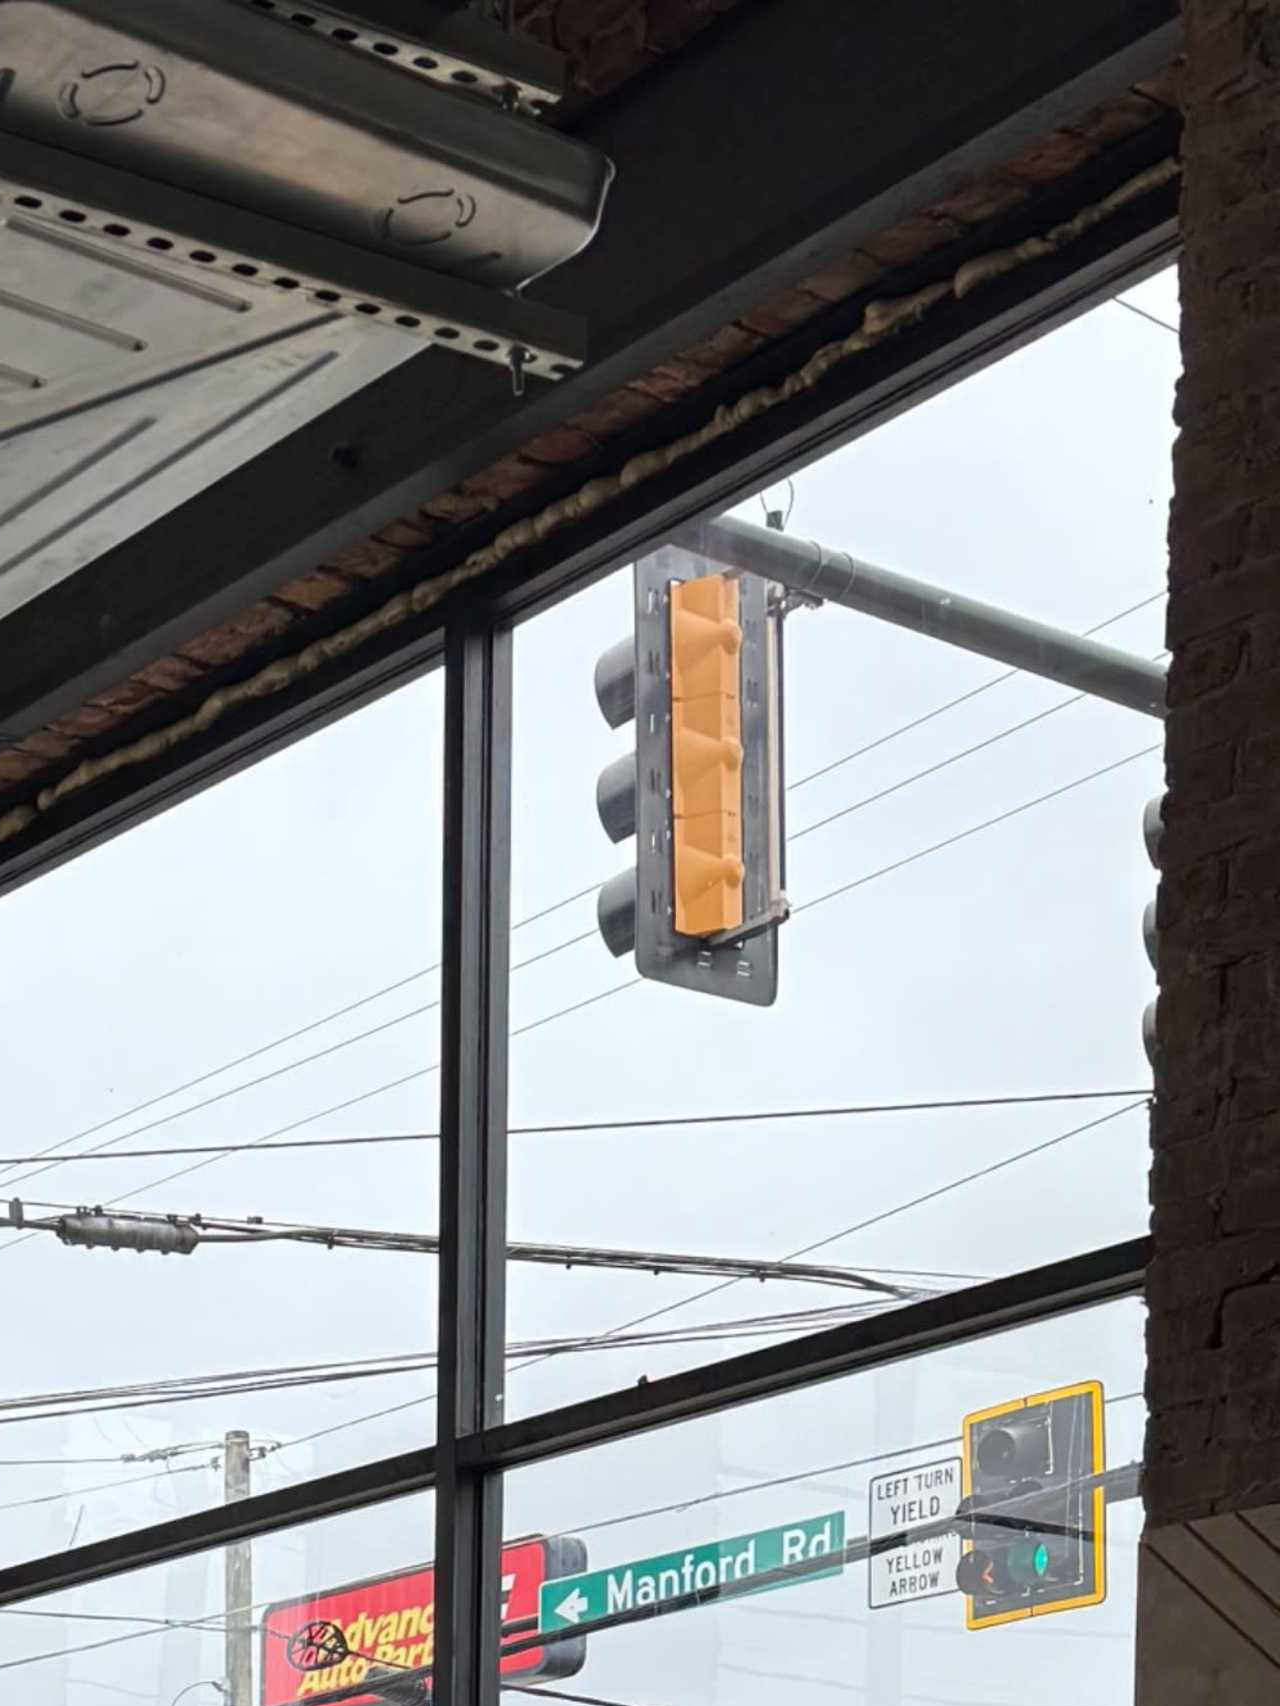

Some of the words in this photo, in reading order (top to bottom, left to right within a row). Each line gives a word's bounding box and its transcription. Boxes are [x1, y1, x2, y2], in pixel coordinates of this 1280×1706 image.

[877, 1478, 908, 1500] LEFT
[914, 1468, 953, 1491] TURN
[890, 1495, 940, 1525] YIELD
[606, 1540, 757, 1615] Manford
[781, 1521, 832, 1565] Rd
[886, 1548, 943, 1574] YELLOW
[889, 1570, 940, 1597] ARROW
[296, 1655, 368, 1697] Auto
